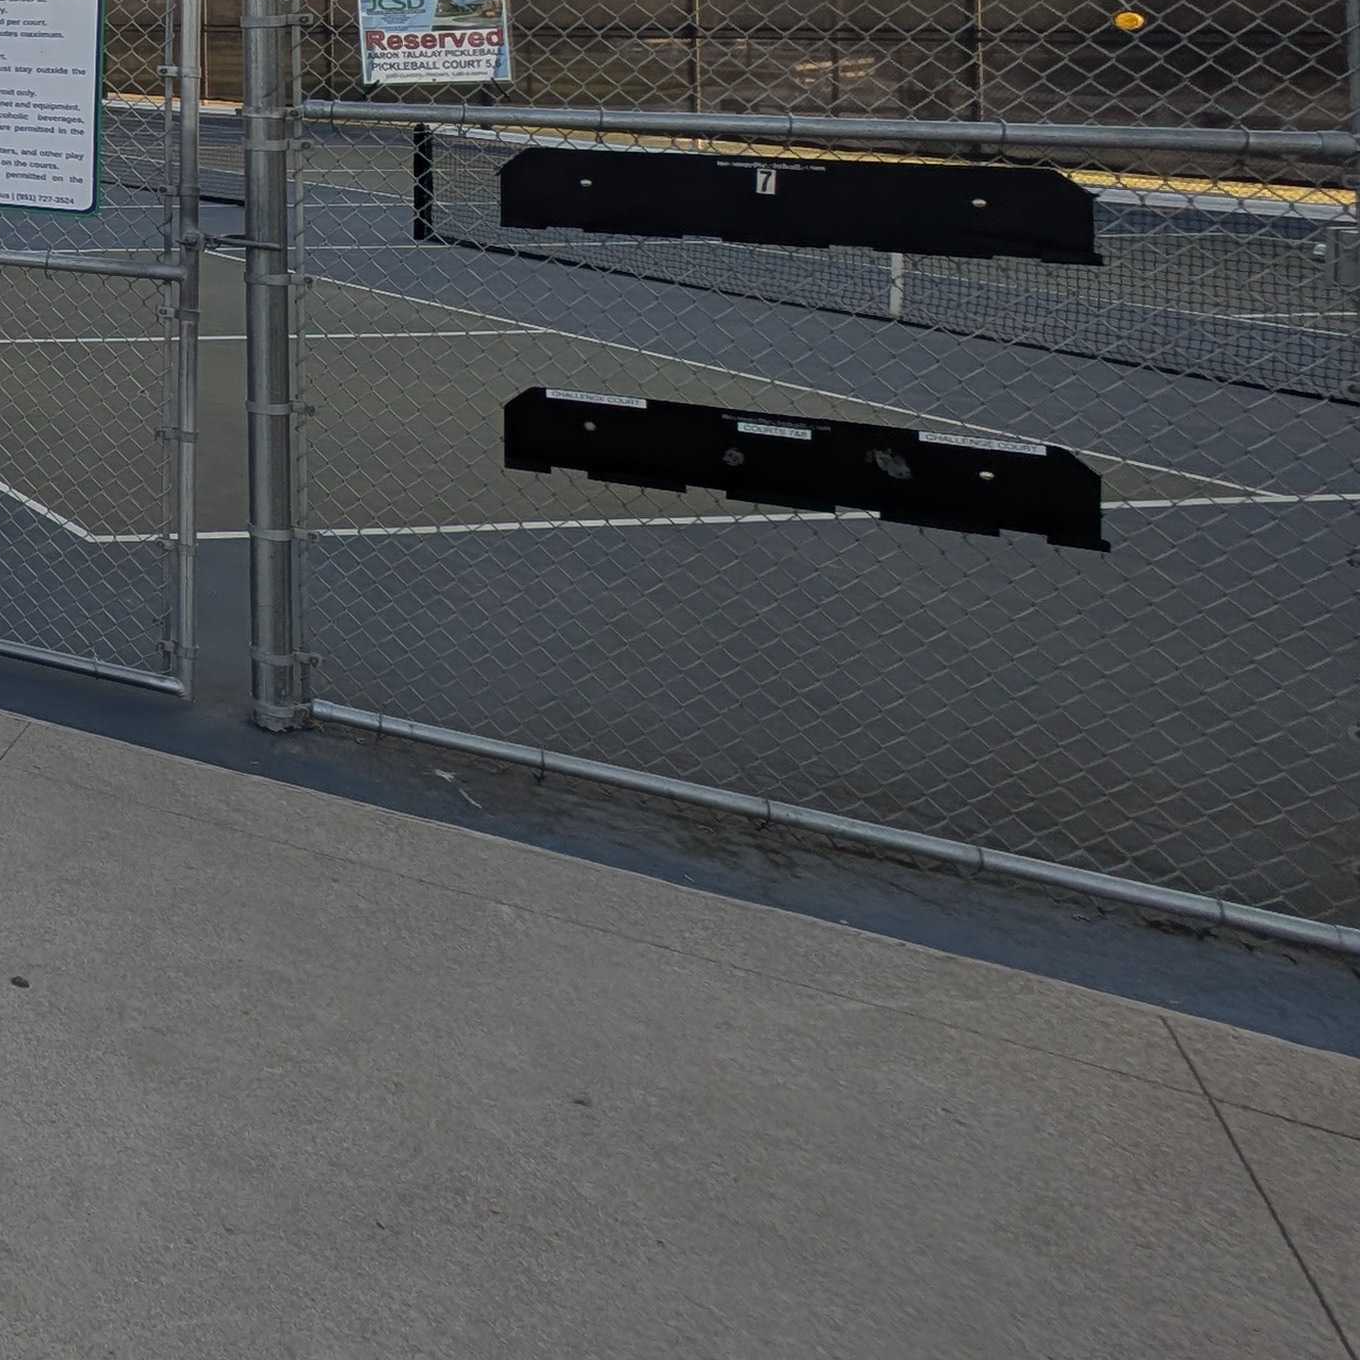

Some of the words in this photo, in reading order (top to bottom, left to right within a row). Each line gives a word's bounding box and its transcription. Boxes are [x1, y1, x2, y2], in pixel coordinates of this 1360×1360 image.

[365, 27, 504, 51] Reserved
[368, 50, 400, 60] AARON
[402, 50, 442, 59] TALALAY
[445, 48, 504, 57] PICKLEBALL
[371, 60, 440, 72] PICKLEBALL
[442, 60, 482, 70] COURT
[760, 170, 772, 193] 7
